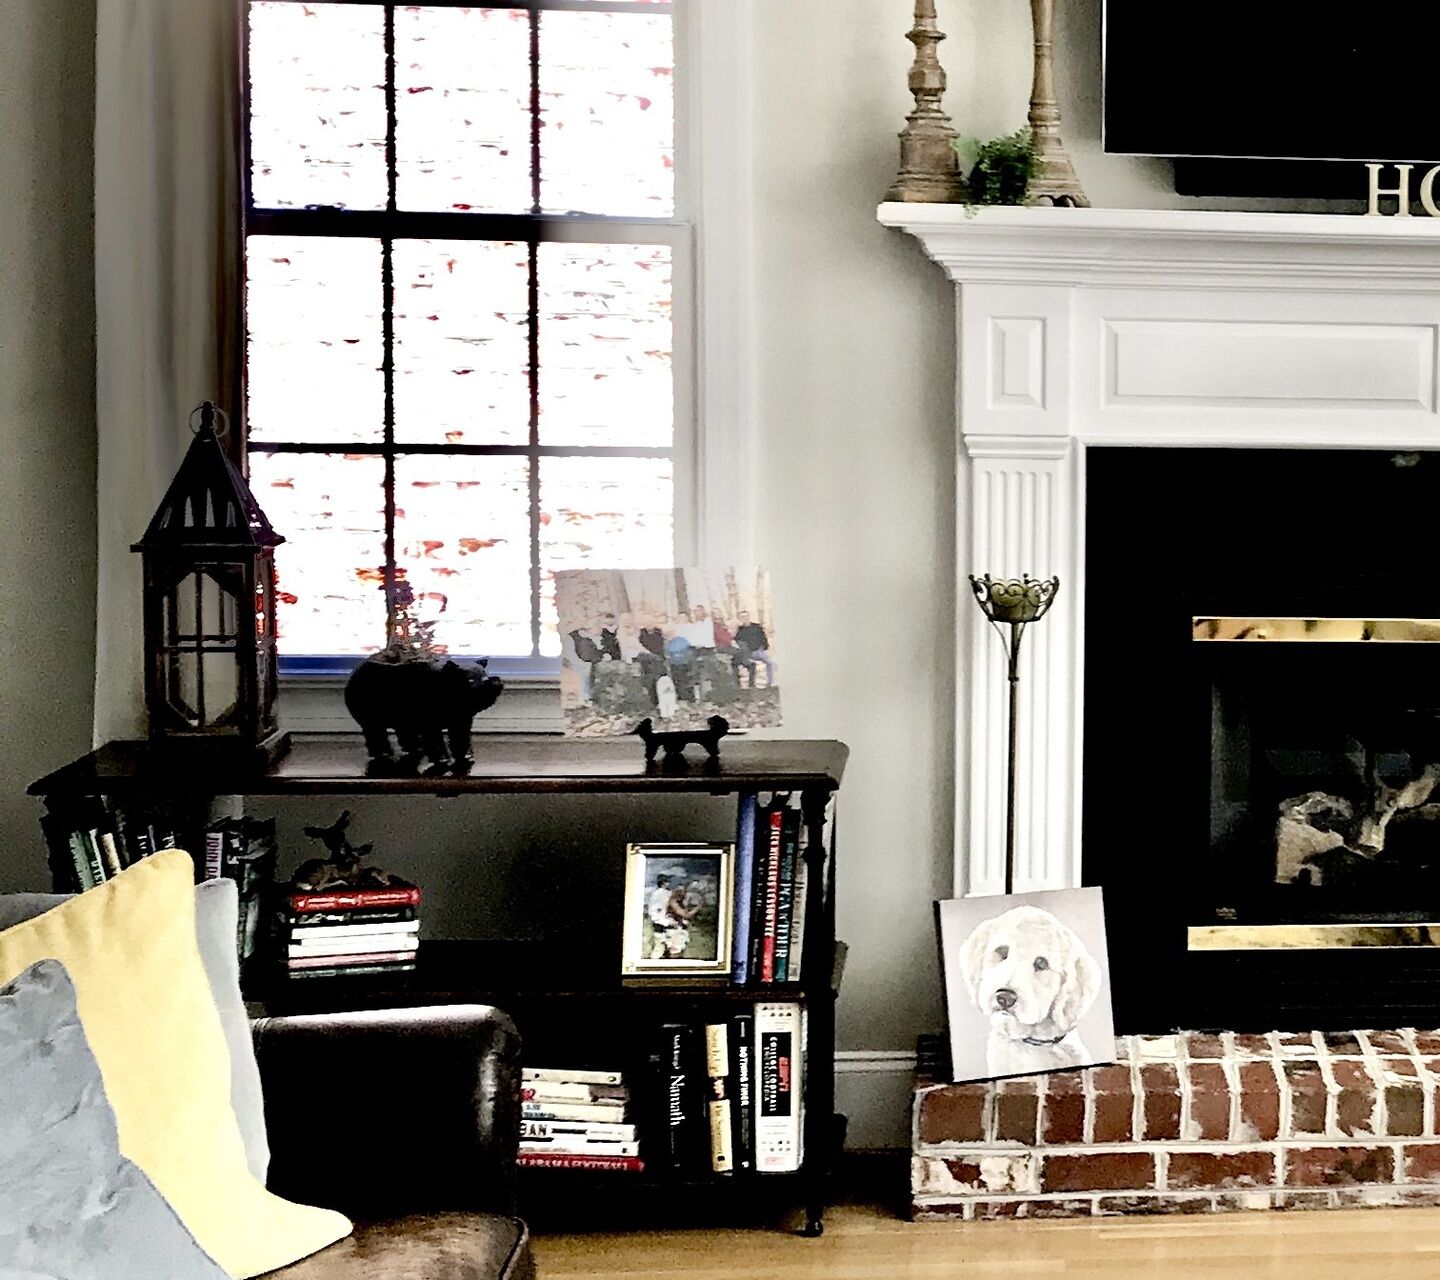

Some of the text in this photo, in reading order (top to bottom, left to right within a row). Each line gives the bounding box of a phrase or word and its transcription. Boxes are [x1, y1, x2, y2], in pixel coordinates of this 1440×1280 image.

[739, 1046, 749, 1083] NOTHING
[769, 1036, 778, 1112] COLLEGE FOOTBALL
[669, 1074, 686, 1126] Namath
[740, 1083, 749, 1107] FINER
